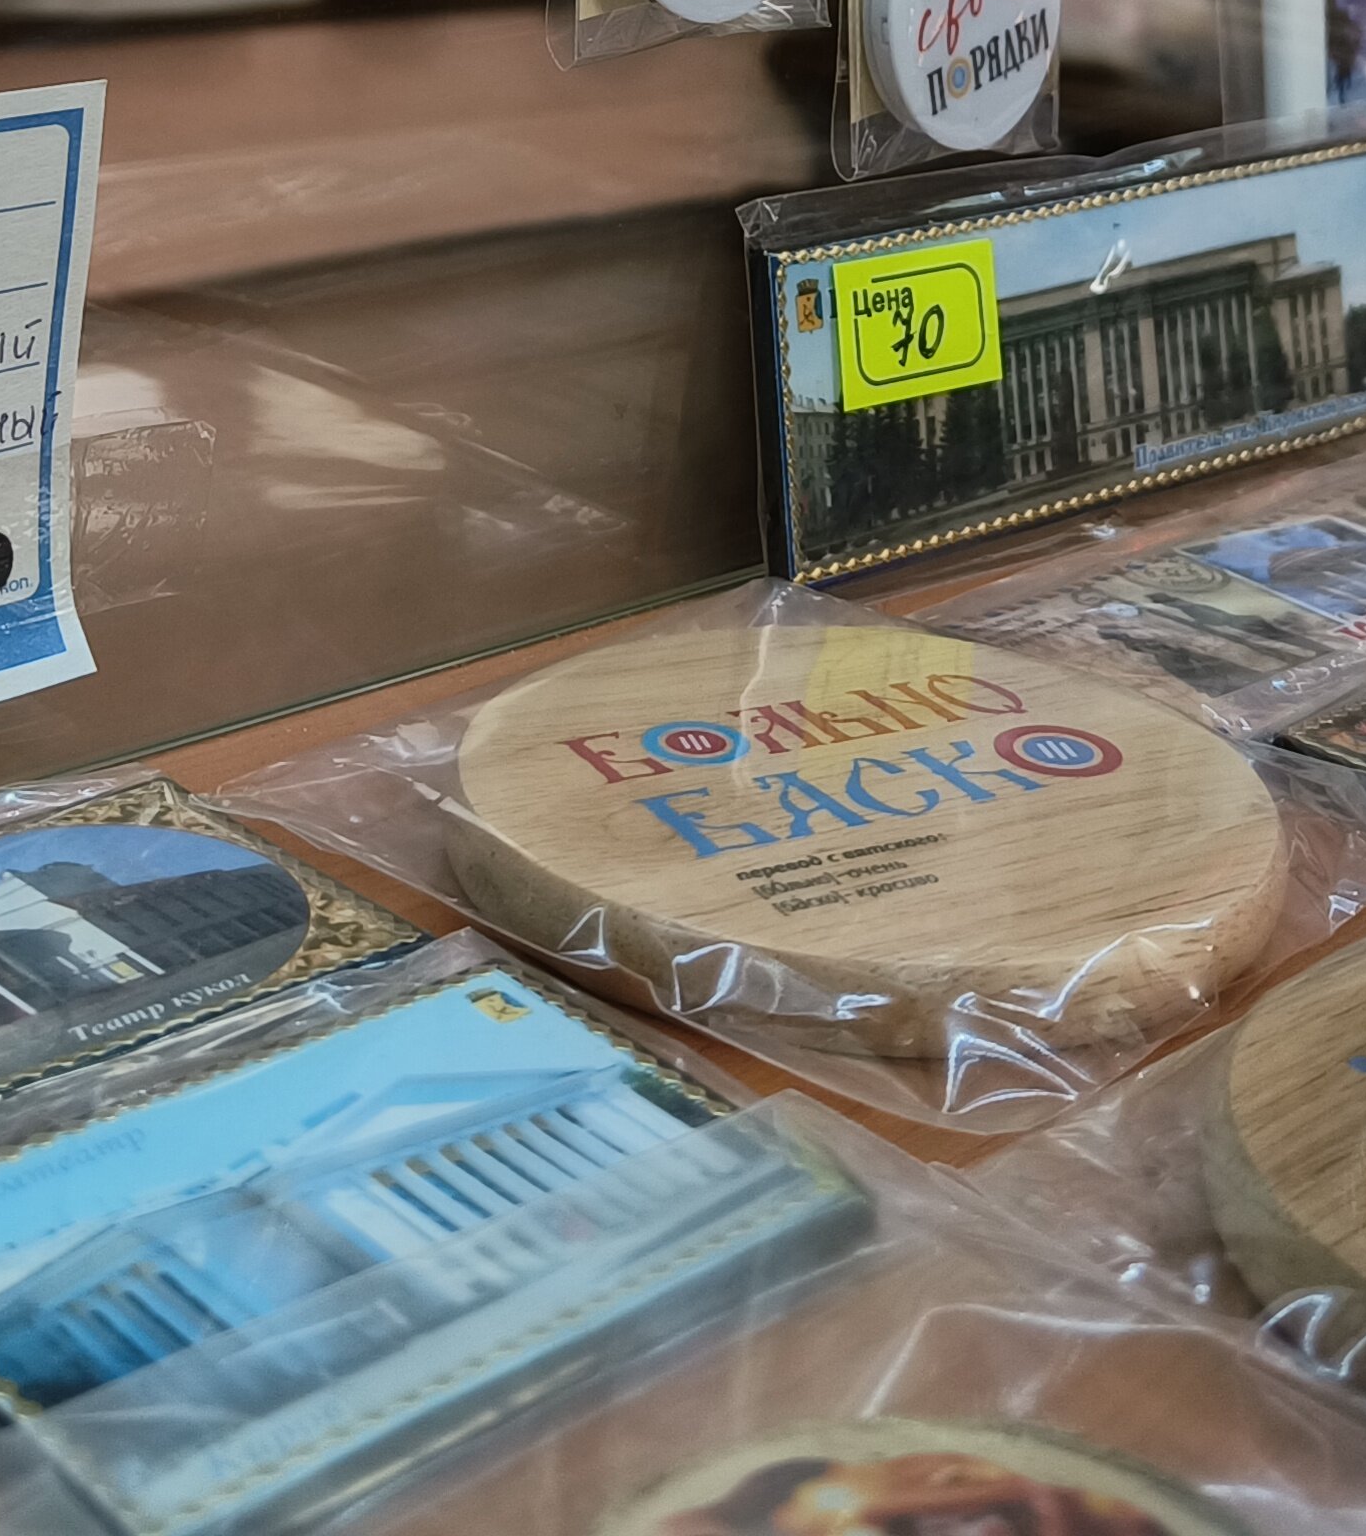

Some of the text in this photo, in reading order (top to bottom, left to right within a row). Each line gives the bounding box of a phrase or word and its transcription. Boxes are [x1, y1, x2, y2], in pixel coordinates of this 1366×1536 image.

[926, 9, 1050, 118] ПОРЯДКИ
[852, 286, 915, 317] Цена
[891, 304, 945, 367] 70
[635, 724, 1124, 860] БАСКО
[67, 972, 253, 1042] Театр кукол
